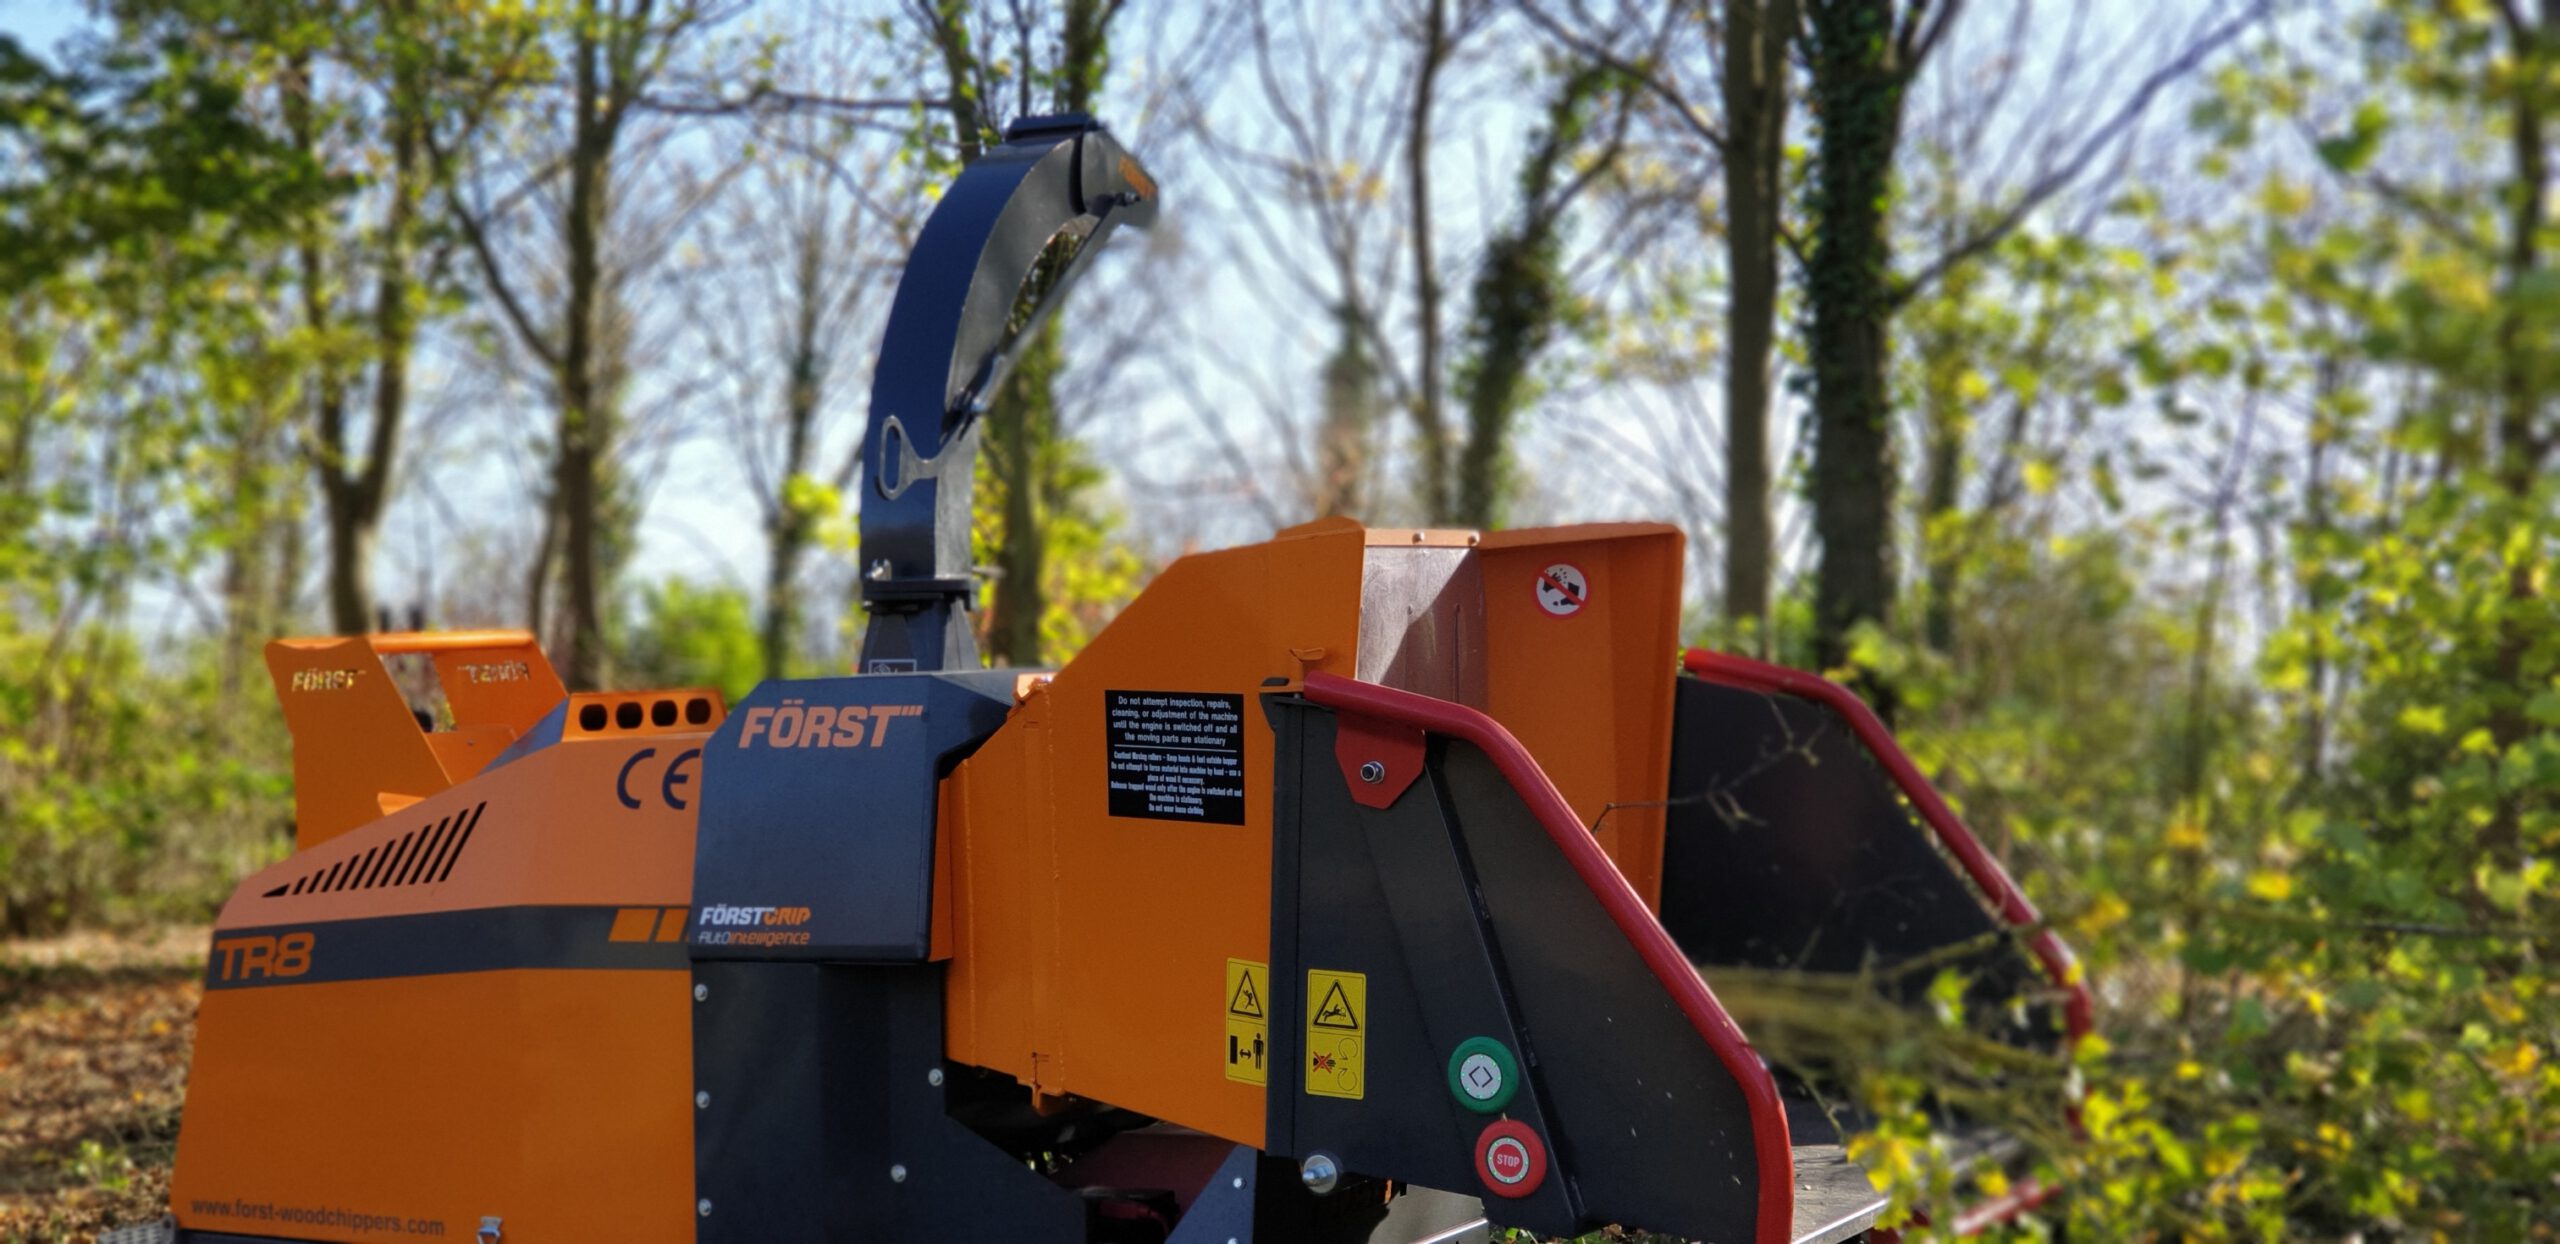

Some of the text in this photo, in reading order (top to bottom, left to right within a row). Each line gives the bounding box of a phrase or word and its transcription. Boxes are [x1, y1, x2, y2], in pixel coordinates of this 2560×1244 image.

[291, 667, 366, 692] FÖRST
[1118, 696, 1231, 710] Do not attempt inspection, repairs,
[738, 699, 923, 749] FÖRST
[1152, 710, 1187, 719] adjustment
[1199, 712, 1208, 720] the
[1211, 712, 1238, 721] machine
[1114, 720, 1126, 728] until
[1129, 721, 1139, 729] the
[1142, 722, 1162, 732] engine
[1165, 722, 1170, 730] is
[1173, 722, 1202, 732] switched
[1204, 724, 1213, 732] off
[1216, 725, 1228, 733] and
[1125, 732, 1135, 740] the
[1138, 733, 1160, 744] moving
[1162, 734, 1178, 744] parts
[1194, 736, 1226, 747] stationary
[616, 747, 701, 811] CE
[216, 931, 315, 981] TR8
[1496, 1153, 1520, 1168] STOP
[191, 1199, 445, 1236] www.forst-woodchippers.com
